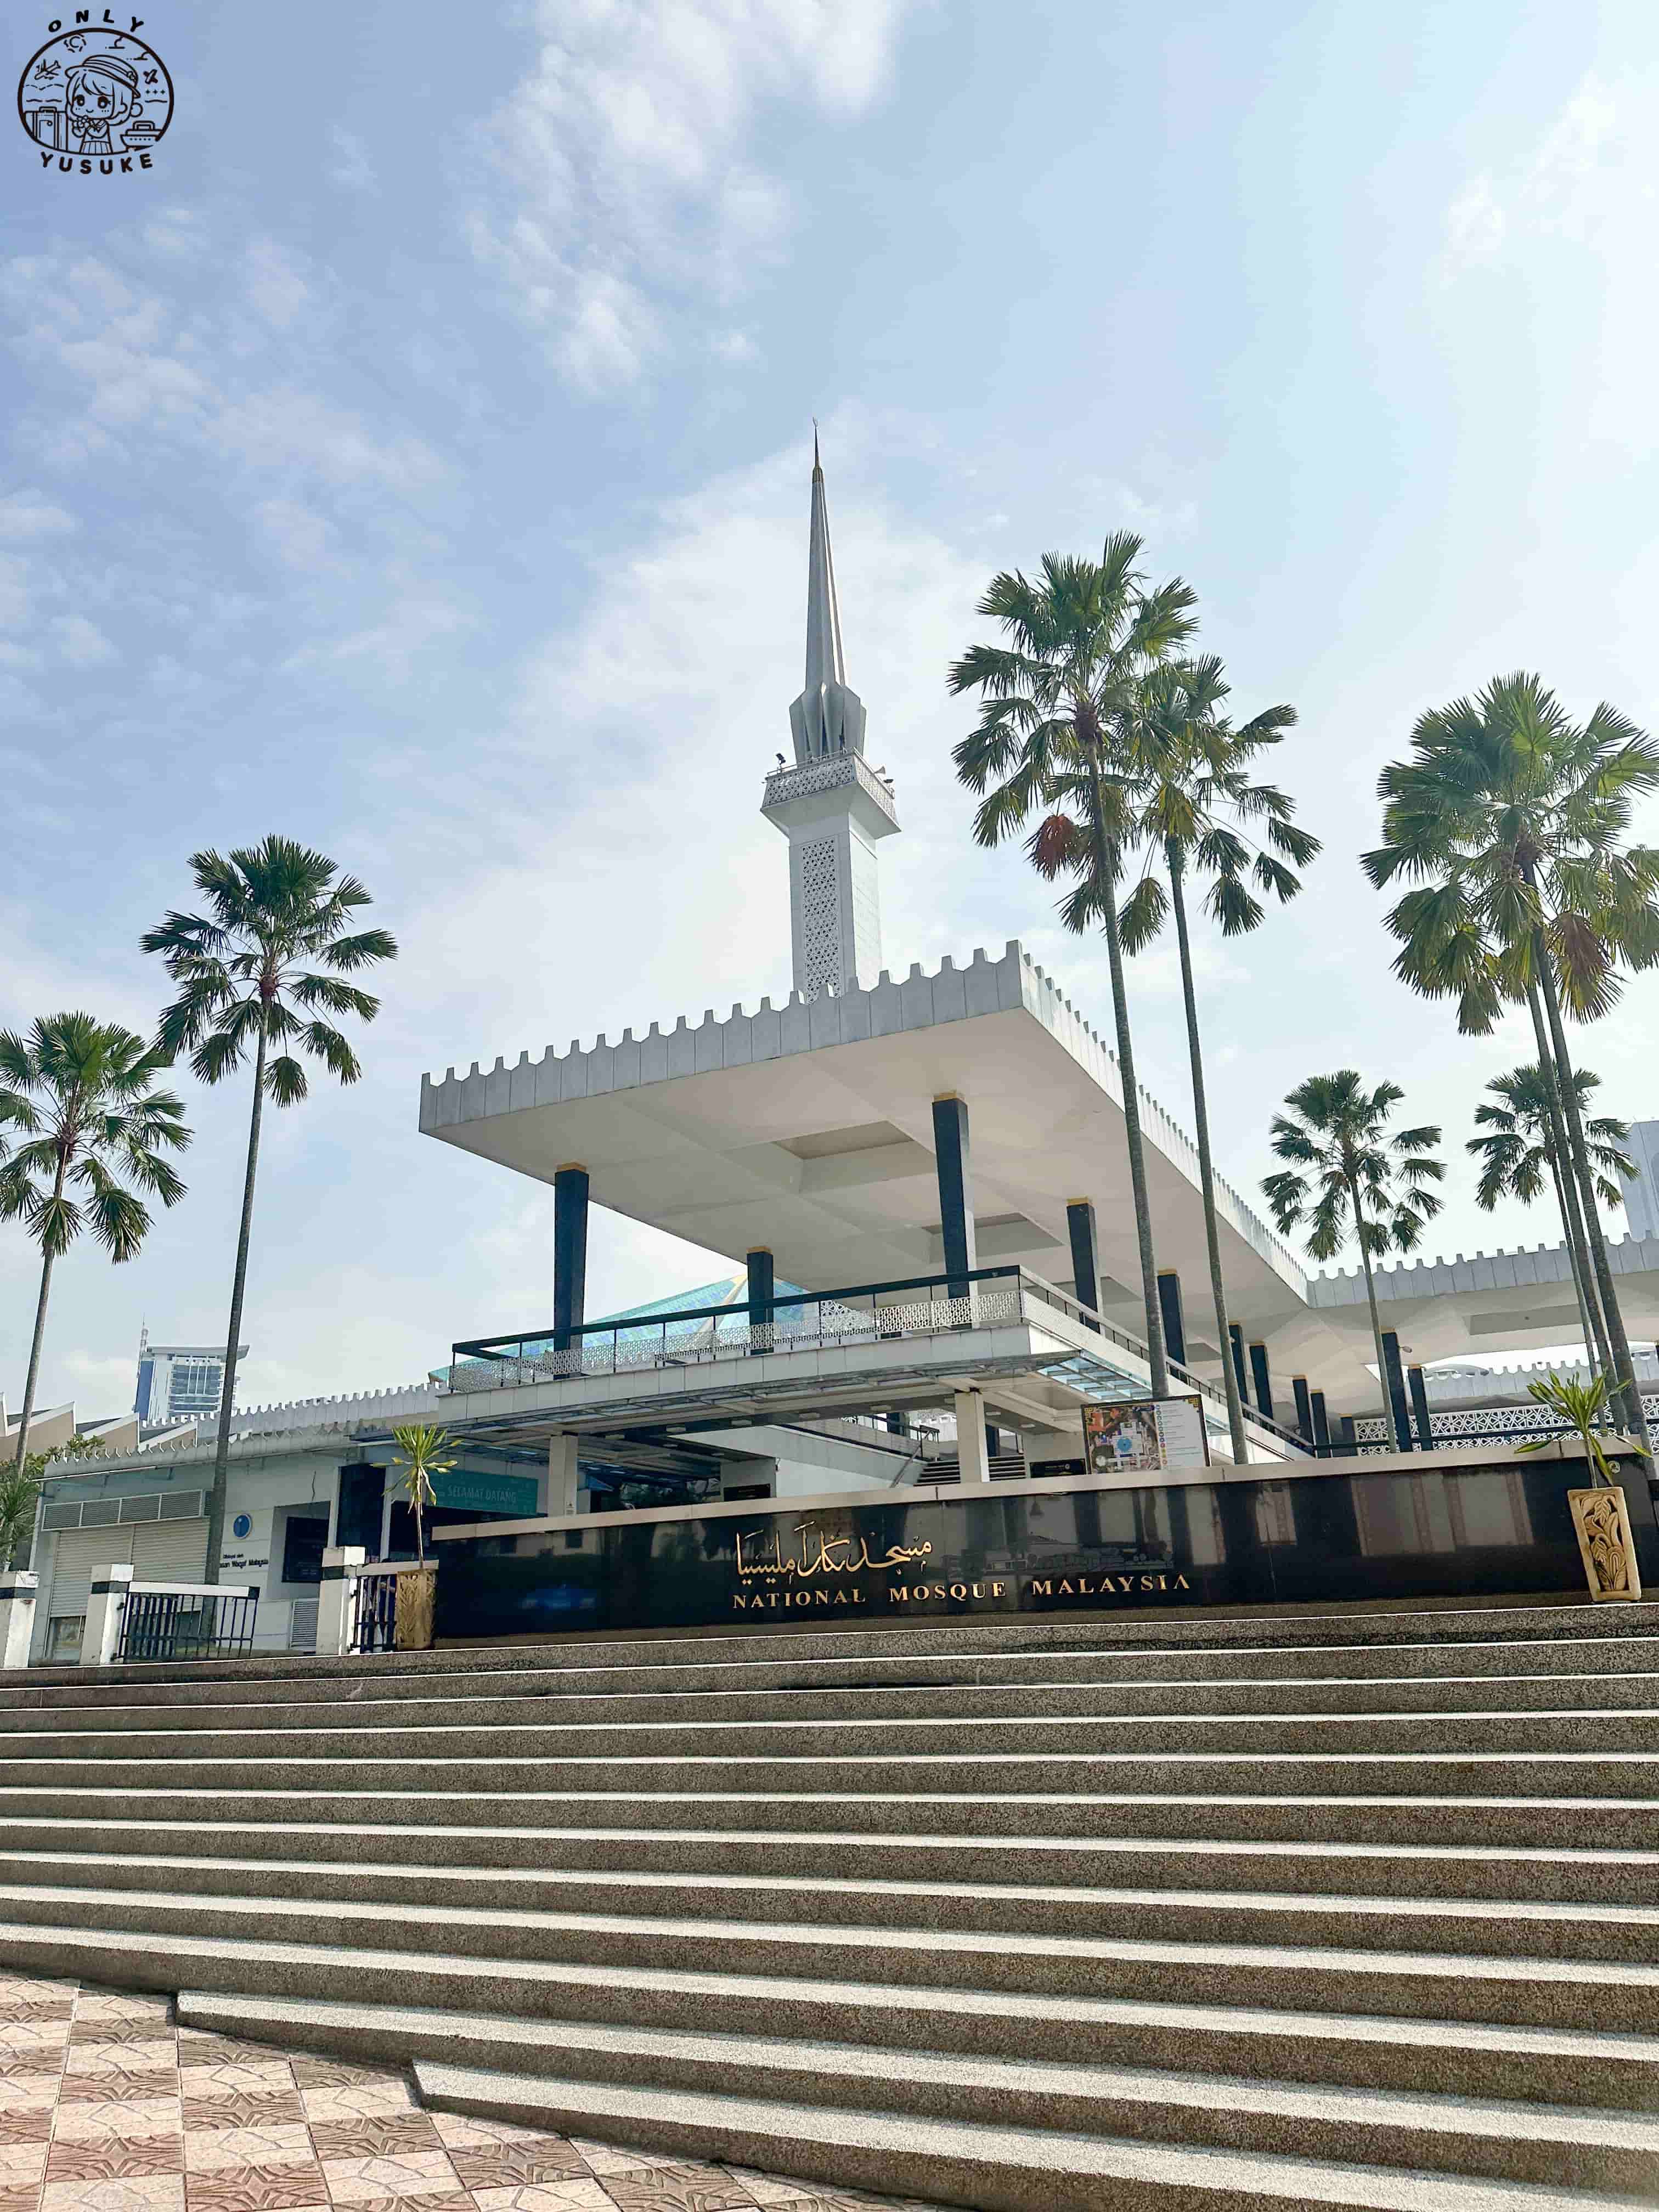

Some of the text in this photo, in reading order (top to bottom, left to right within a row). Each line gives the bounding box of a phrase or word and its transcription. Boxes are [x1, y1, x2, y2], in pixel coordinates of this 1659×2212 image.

[733, 1574, 1190, 1609] NATIONAL MOSQUE MALAYSIA
